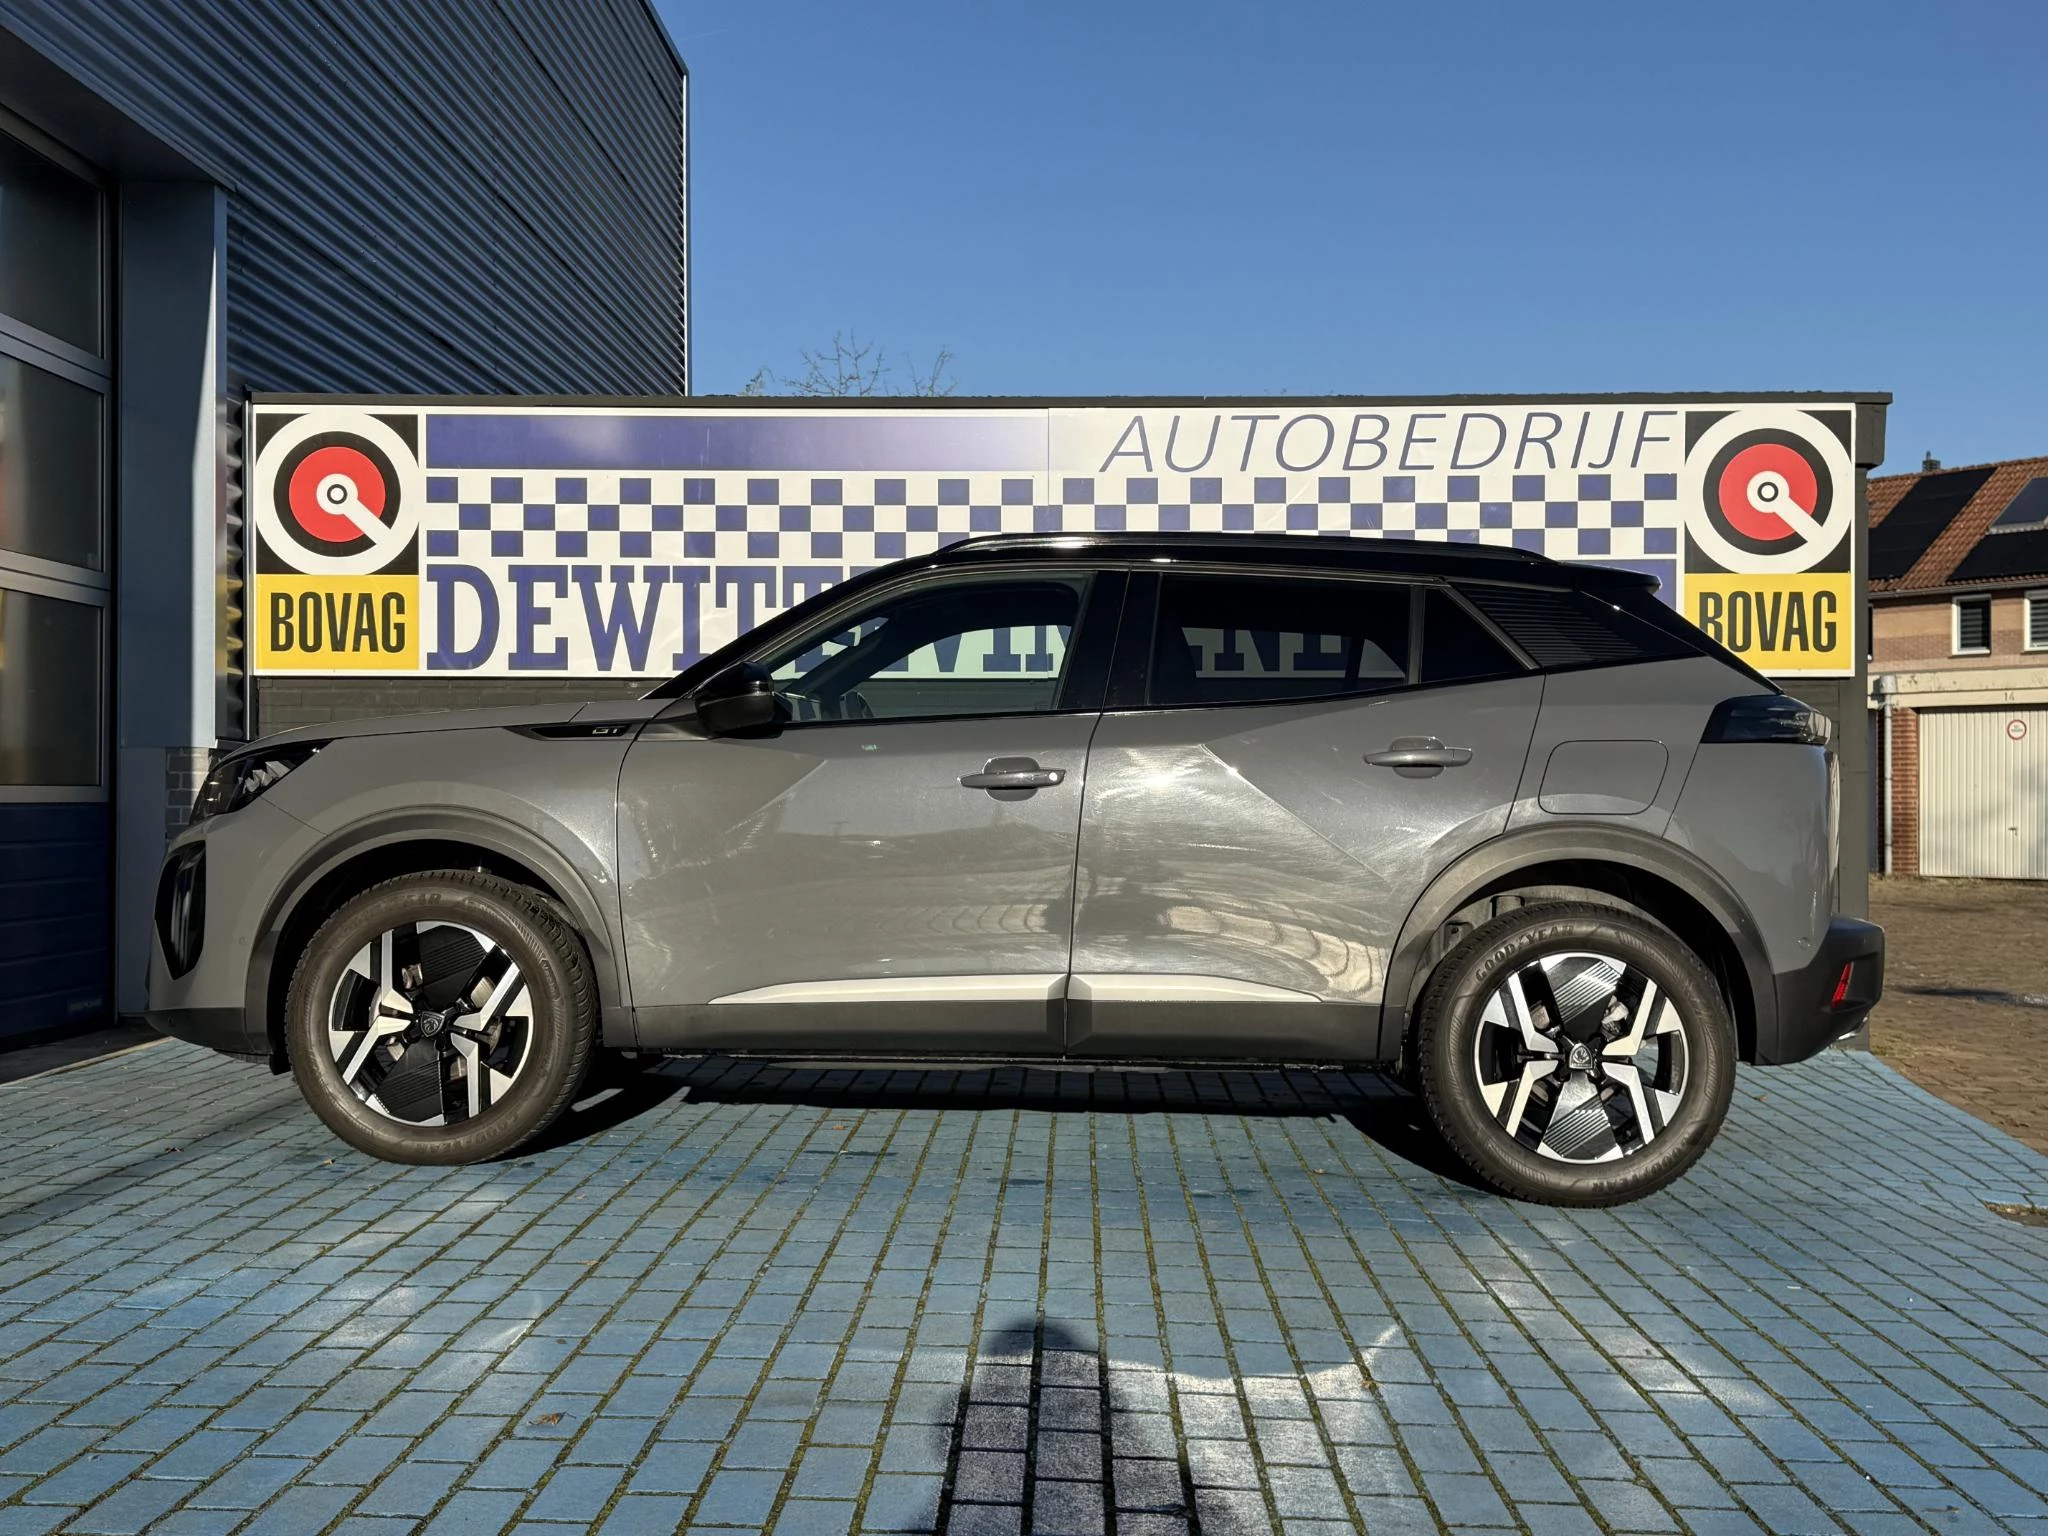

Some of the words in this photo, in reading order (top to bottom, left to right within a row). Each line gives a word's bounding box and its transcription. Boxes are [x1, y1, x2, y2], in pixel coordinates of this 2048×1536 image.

[1099, 411, 1678, 473] AUTOBEDRIJF
[271, 592, 405, 652] BOVAG
[1699, 591, 1837, 652] BOVAG
